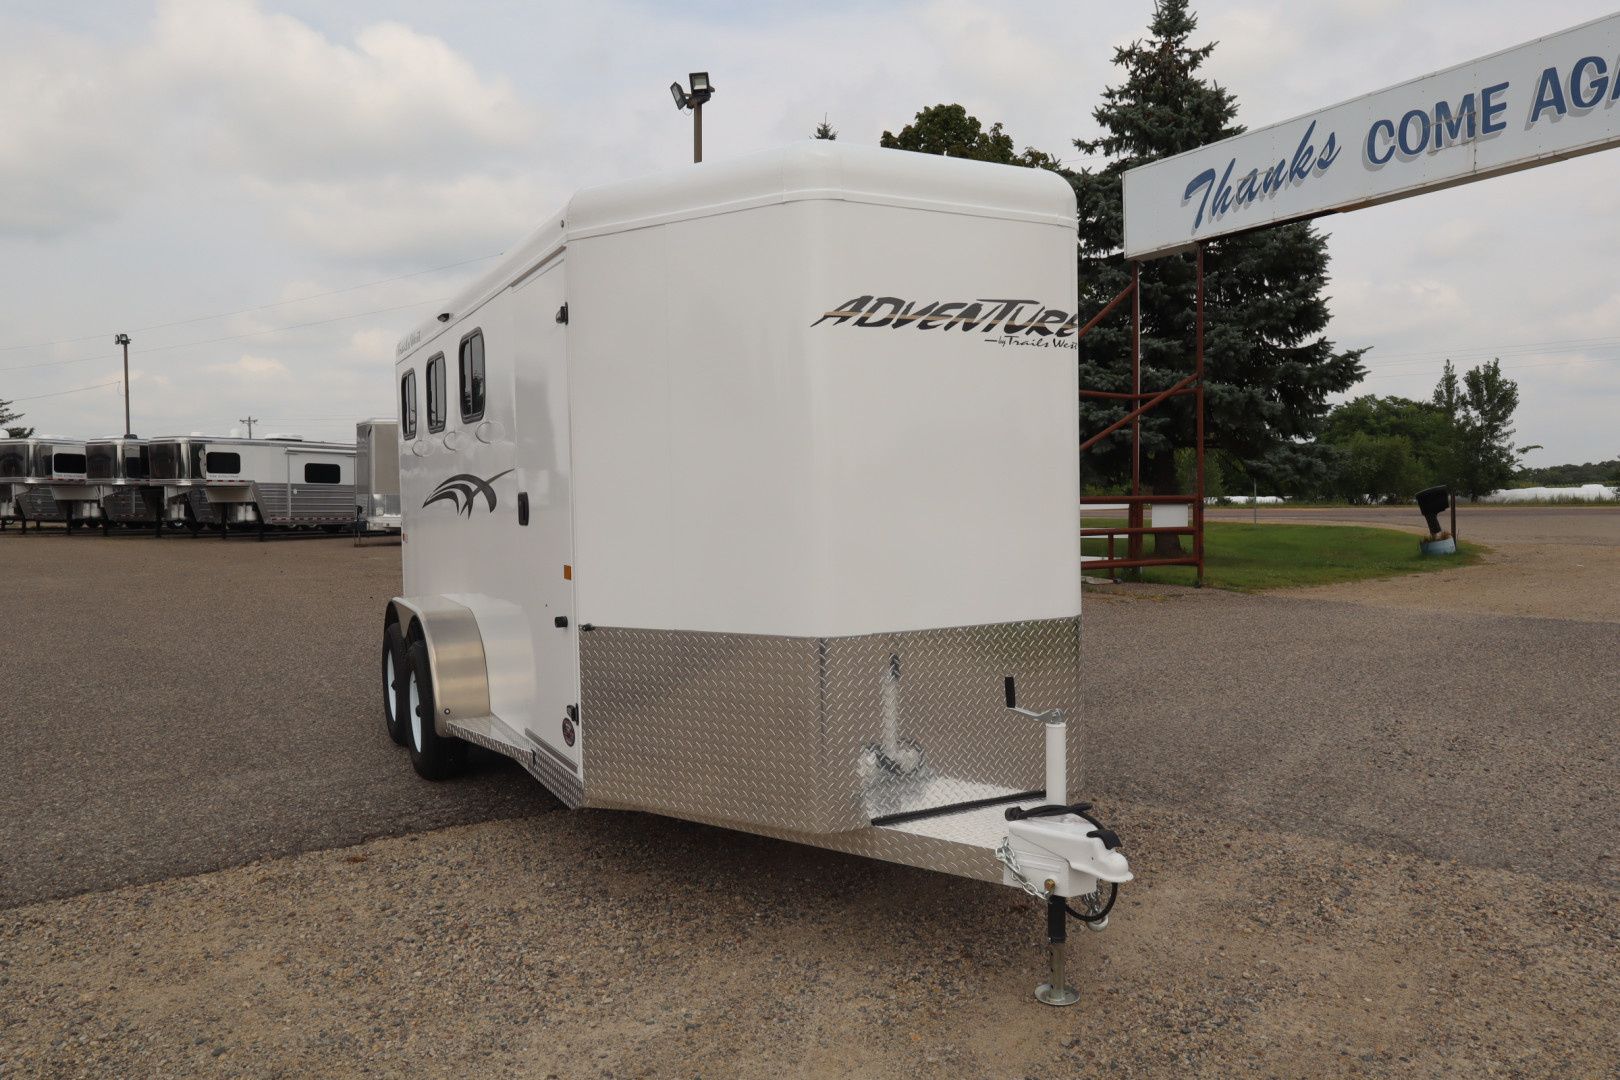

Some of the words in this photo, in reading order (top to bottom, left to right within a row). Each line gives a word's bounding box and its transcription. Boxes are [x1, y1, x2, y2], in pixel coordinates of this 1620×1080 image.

[1184, 119, 1342, 230] Thanks
[1365, 81, 1510, 166] COME
[1529, 55, 1620, 123] AG
[1005, 335, 1049, 348] Trails
